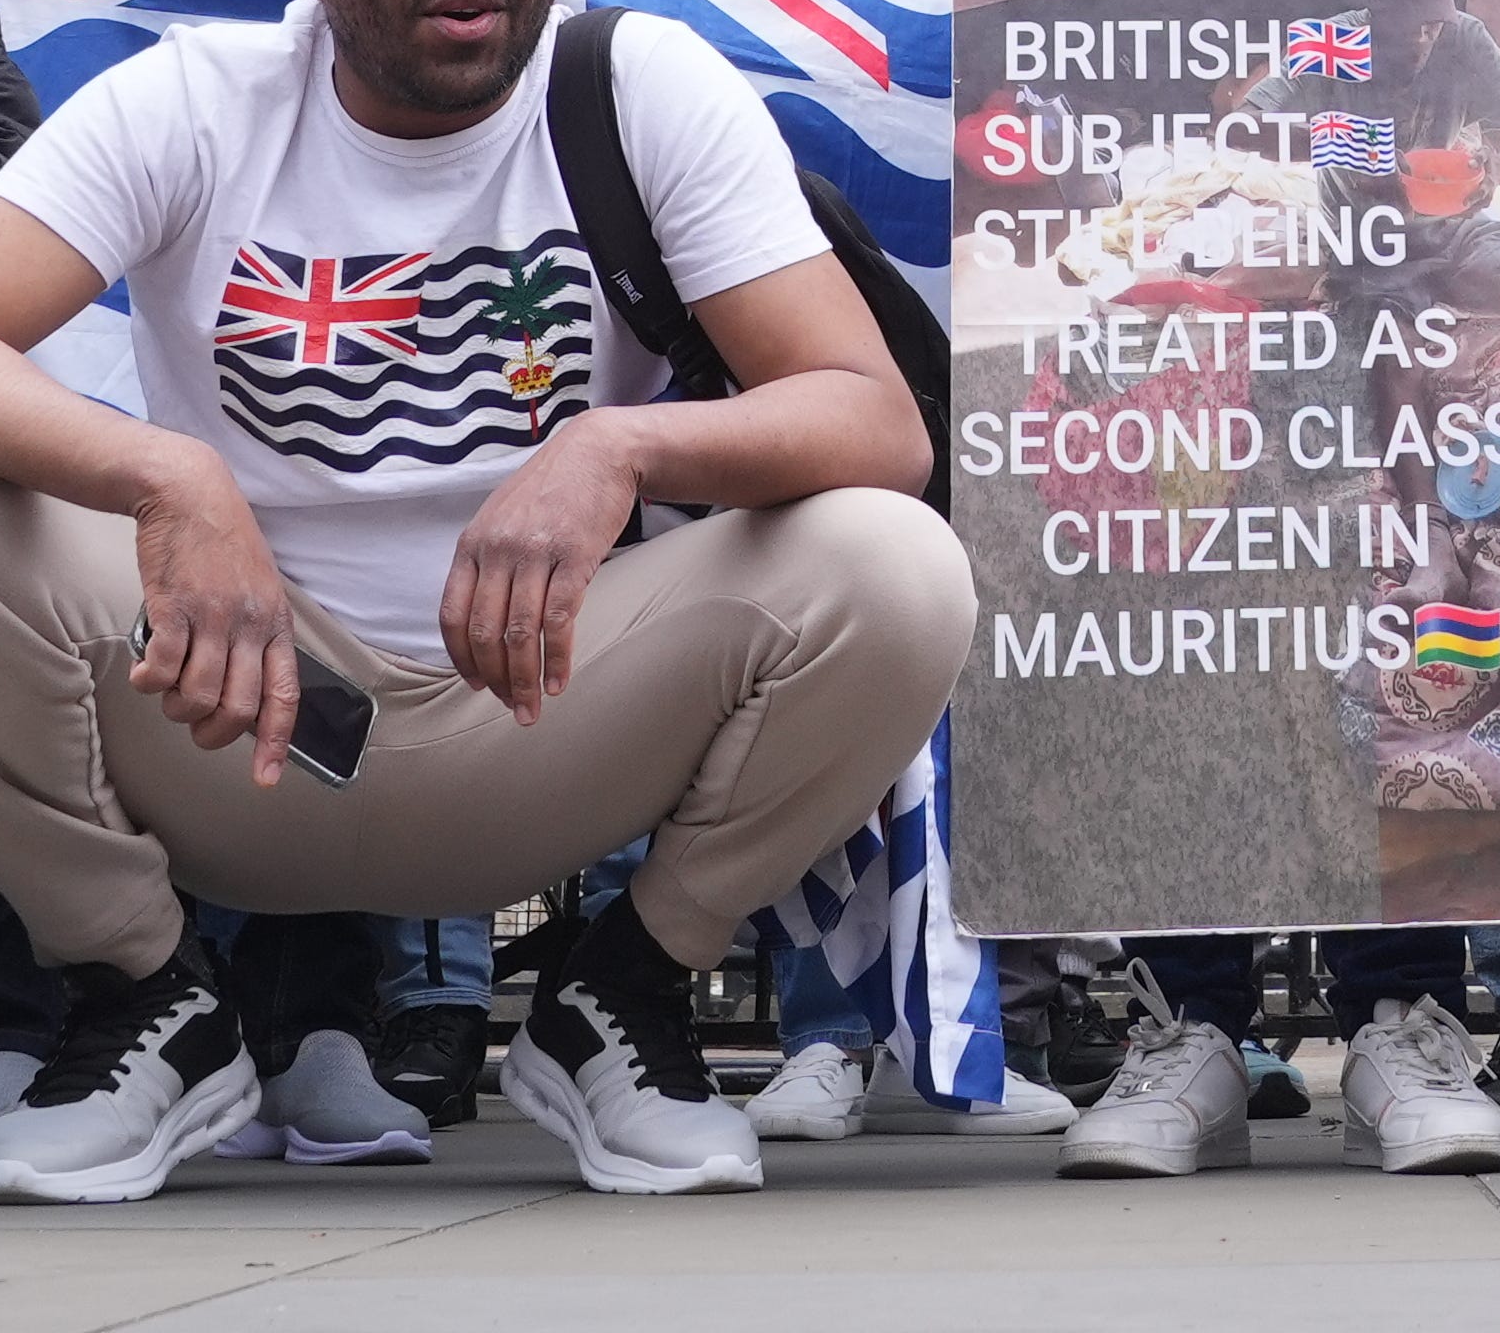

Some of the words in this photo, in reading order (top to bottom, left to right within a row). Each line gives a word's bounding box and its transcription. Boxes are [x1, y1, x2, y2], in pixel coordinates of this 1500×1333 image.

[1004, 19, 1280, 83] BRITISH
[1193, 204, 1407, 270] BEING
[1020, 310, 1338, 376] TREATED
[1359, 308, 1459, 370] AS
[959, 406, 1264, 478] SECOND
[1041, 506, 1337, 576] CITIZEN
[1358, 504, 1431, 568] IN
[993, 603, 1413, 680] MAURITIUS
